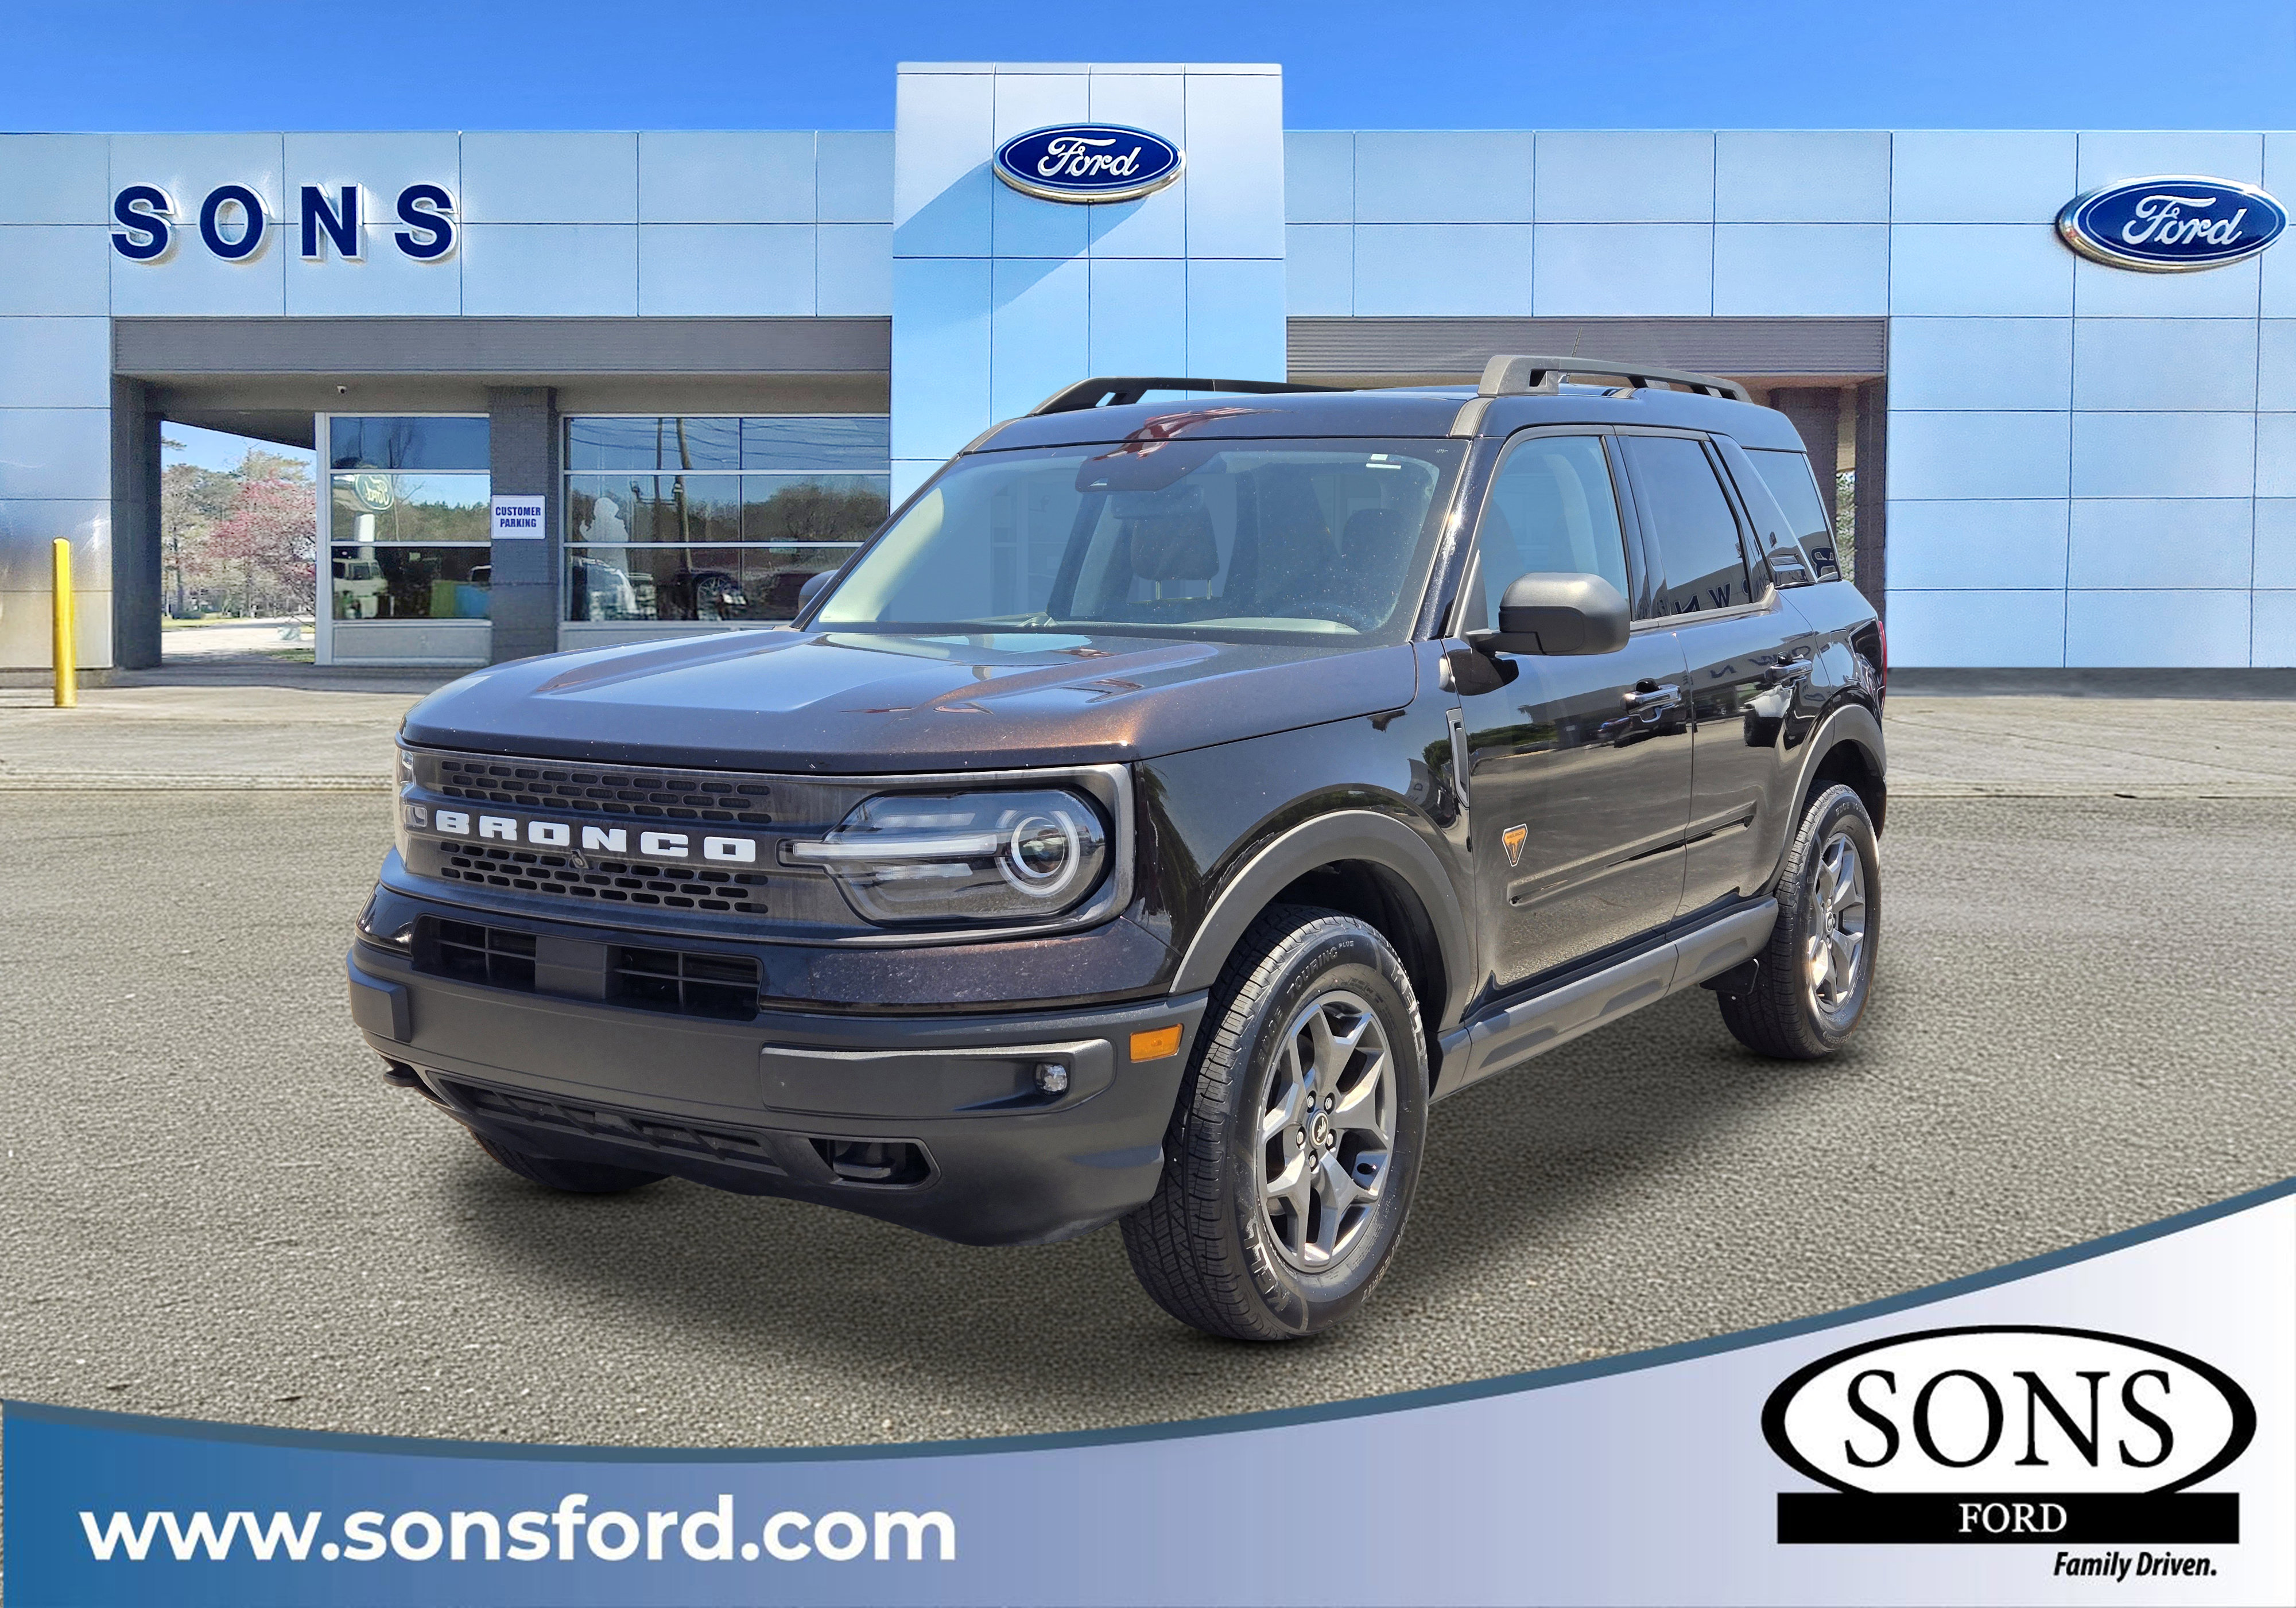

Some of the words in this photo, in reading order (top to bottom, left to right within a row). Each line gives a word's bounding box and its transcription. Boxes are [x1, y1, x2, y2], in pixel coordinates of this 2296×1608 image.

[1037, 137, 1142, 177] Ford
[110, 182, 457, 261] SONS
[2122, 195, 2247, 245] Ford
[495, 506, 541, 516] CUSTOMER
[500, 518, 537, 527] PARKING
[436, 809, 755, 863] BRONCO
[1286, 946, 1339, 1000] TOURING
[1338, 940, 1355, 950] PLUS
